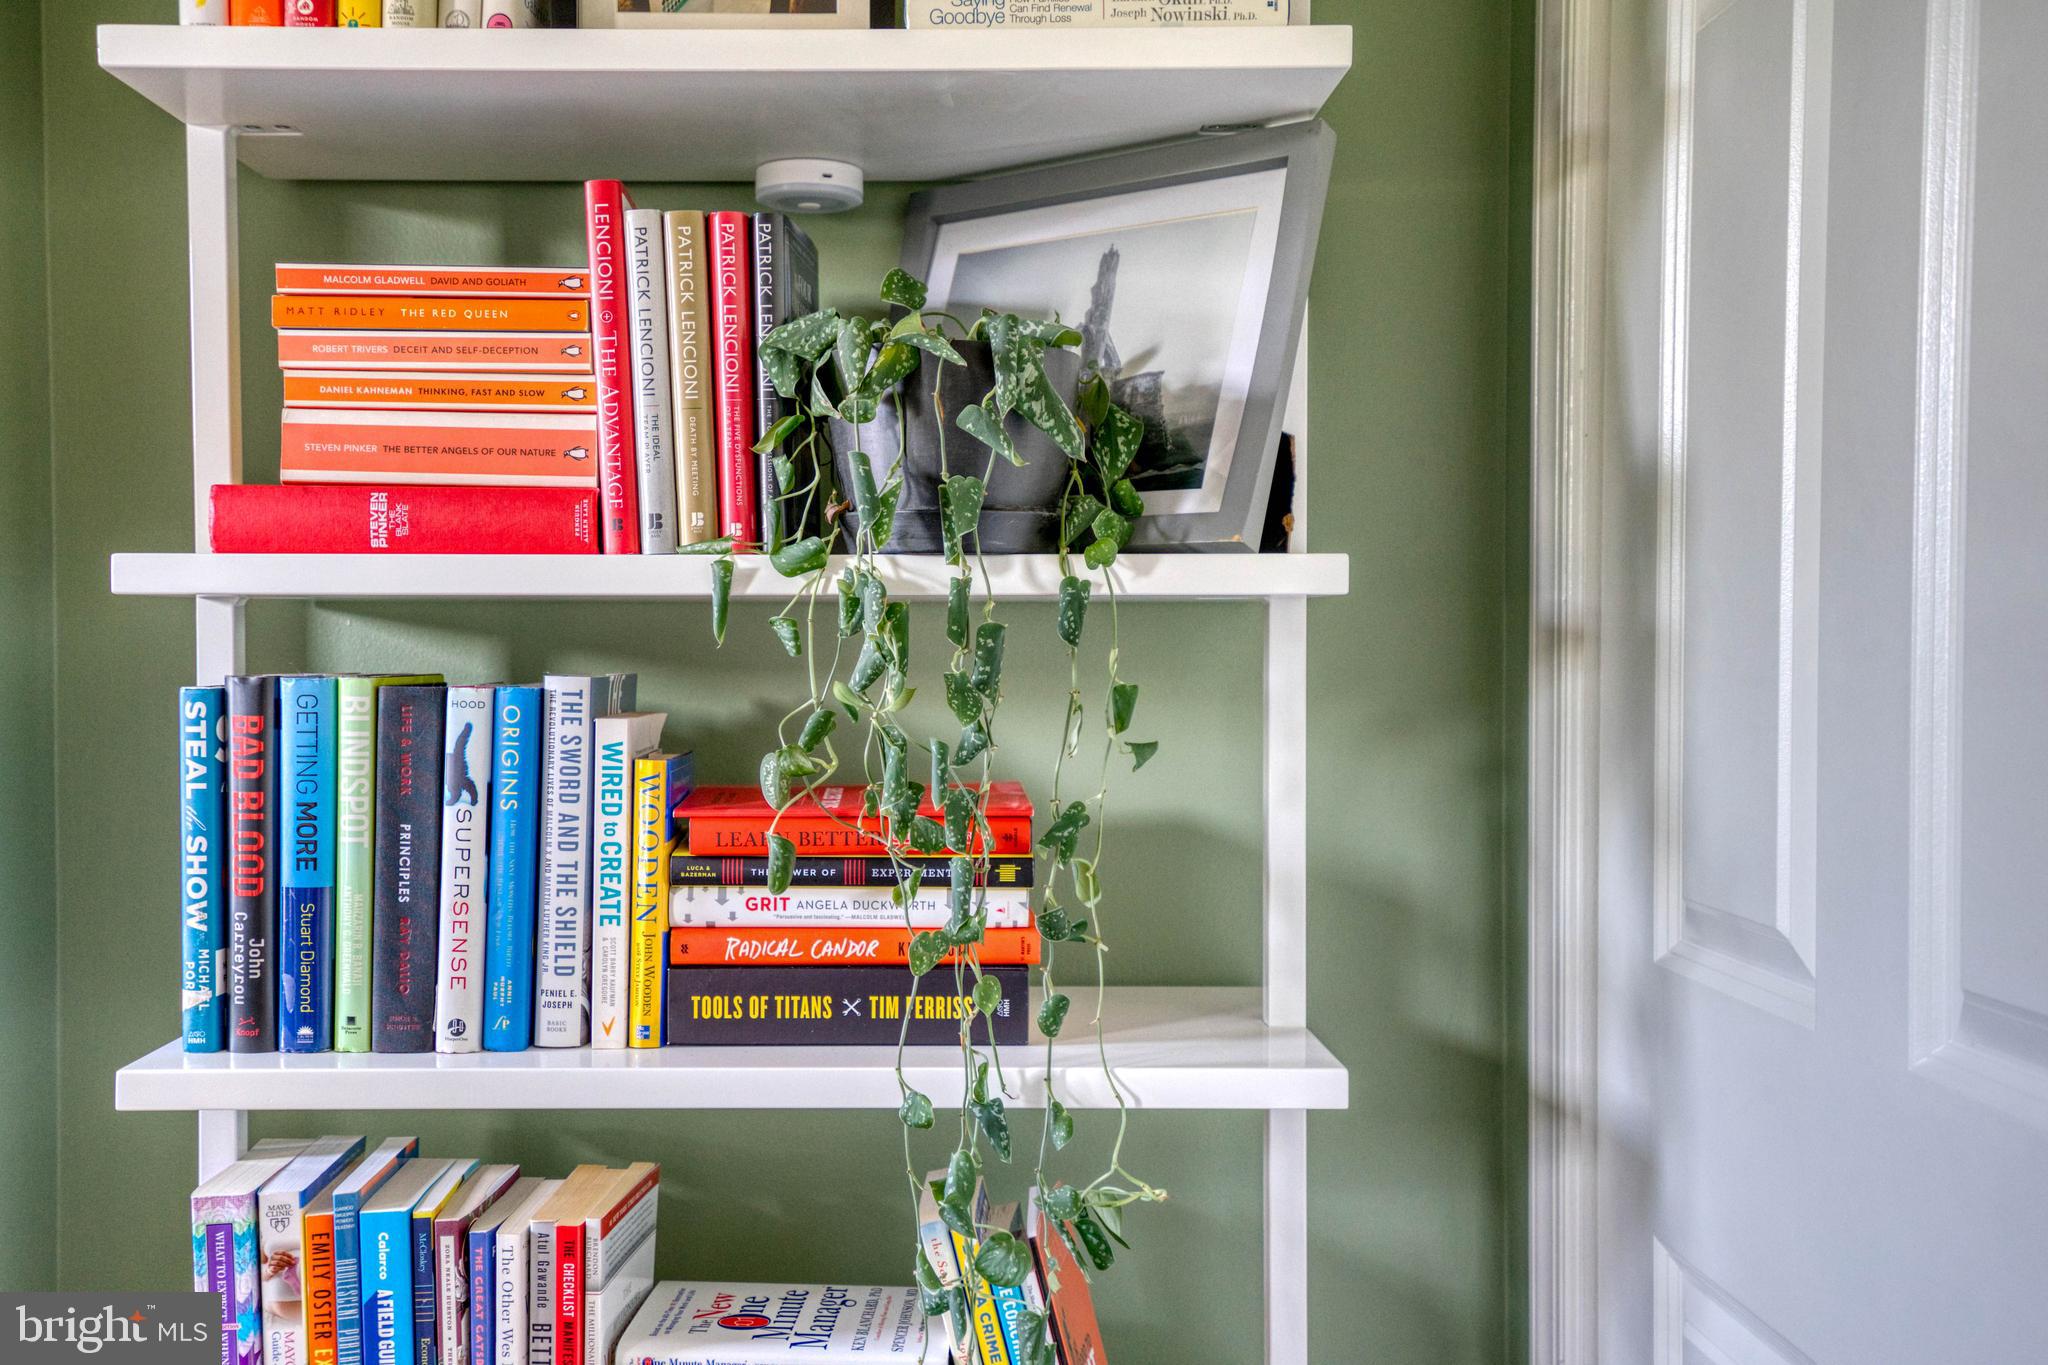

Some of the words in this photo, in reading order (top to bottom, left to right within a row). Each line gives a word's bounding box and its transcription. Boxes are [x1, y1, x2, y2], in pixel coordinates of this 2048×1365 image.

[929, 9, 1005, 27] Goodbye
[1009, 4, 1029, 13] Can
[1031, 4, 1050, 12] Find
[1053, 4, 1092, 12] Renewal
[1010, 14, 1047, 25] Through
[1049, 14, 1071, 23] Loss
[1110, 8, 1147, 19] Joseph
[1233, 12, 1258, 20] Ph.D.
[594, 203, 613, 300] LENCIONI
[634, 227, 651, 300] PATRICK
[678, 225, 695, 304] PATRICK
[720, 223, 737, 297] PATRICK
[758, 223, 773, 297] PATRICK
[323, 275, 371, 284] MALCOLM
[374, 276, 425, 285] GLADWELL
[430, 277, 460, 285] DAVID
[462, 278, 483, 286] AND
[486, 278, 527, 286] GOLIATH
[286, 307, 325, 316] MATT
[334, 307, 385, 316] RIDLEY
[400, 308, 425, 317] THE
[432, 309, 457, 318] RED
[464, 309, 509, 319] QUEEN
[312, 345, 349, 353] ROBERT
[352, 345, 388, 353] TRIVERS
[393, 346, 428, 354] DECEIT
[431, 346, 453, 354] AND
[456, 346, 539, 355] SELF-DECEPTION
[599, 330, 617, 377] THE
[638, 308, 655, 397] LENCIONI
[681, 311, 698, 400] LENCIONI
[722, 304, 739, 394] LENCIONI
[319, 385, 353, 394] DANIEL
[356, 386, 413, 395] KAHNEMAN
[418, 388, 468, 396] THINKING,
[471, 388, 492, 396] FAST
[495, 389, 516, 397] AND
[518, 389, 545, 397] SLOW
[651, 415, 660, 431] THE
[304, 443, 341, 452] STEVEN
[344, 444, 377, 453] PINKER
[383, 445, 401, 453] THE
[404, 445, 439, 454] BETTER
[441, 446, 479, 455] ANGELS
[481, 447, 494, 455] OF
[497, 448, 517, 456] OUR
[520, 449, 557, 457] NATURE
[602, 386, 623, 509] ADVANTAGE
[652, 433, 661, 461] IDEAL
[691, 460, 699, 497] MEETING
[734, 444, 743, 506] DYSFUNCTIONS
[369, 492, 379, 548] STEVEN
[378, 492, 388, 548] PINKER
[401, 704, 413, 733] LIFE
[451, 700, 486, 709] HOOD
[561, 689, 583, 726] THE
[185, 701, 207, 800] STEAL
[232, 715, 265, 779] BAD
[296, 694, 318, 795] GETTING
[500, 705, 521, 811] ORIGINS
[340, 695, 370, 848] BLINDSPOT
[400, 753, 412, 796] WORK
[559, 735, 582, 804] SWORD
[601, 741, 624, 816] WIRED
[185, 805, 207, 832] the
[296, 802, 318, 871] MORE
[558, 812, 580, 852] AND
[603, 821, 618, 837] to
[232, 792, 265, 897] BLOOD
[636, 771, 661, 924] WOODEN
[799, 832, 887, 847] BETTER
[398, 823, 411, 903] PRINCIPLES
[556, 860, 578, 898] THE
[186, 835, 208, 932] SHOW
[450, 808, 472, 990] SUPERSENSE
[600, 841, 622, 927] CREATE
[745, 897, 790, 911] GRIT
[797, 900, 848, 910] ANGELA
[853, 901, 936, 911] DUCKRTH
[300, 903, 315, 946] Stuart
[554, 906, 577, 977] SHIELD
[232, 912, 248, 1005] Carreyrou
[249, 938, 265, 979] John
[642, 930, 656, 962] JOHN
[725, 937, 803, 960] RADICAL
[811, 938, 880, 960] CANDOR
[300, 951, 315, 1013] Diamond
[540, 988, 567, 998] PENIEL
[569, 989, 577, 998] E.
[643, 965, 656, 1017] WOODEN
[542, 1000, 573, 1009] JOSEPH
[691, 995, 743, 1019] TOOLS
[749, 996, 768, 1019] OF
[775, 995, 833, 1019] TITANS
[869, 995, 899, 1019] TIM
[187, 1037, 206, 1045] HMH
[236, 1027, 260, 1037] Knopf
[268, 1203, 291, 1211] MAYO
[215, 1231, 226, 1262] WHAT
[312, 1233, 330, 1280] EMILY
[378, 1232, 390, 1280] Calarco
[418, 1233, 428, 1273] McCloskey
[475, 1248, 483, 1271] THE
[502, 1246, 514, 1274] The
[537, 1233, 550, 1254] Atul
[563, 1241, 575, 1258] THE
[931, 1238, 940, 1257] the
[216, 1264, 227, 1279] TO
[335, 1258, 359, 1320] ADOLESCENT
[537, 1261, 550, 1308] Gawande
[563, 1263, 575, 1317] CHECKLIST
[376, 1289, 394, 1299] A
[475, 1277, 484, 1319] GREAT
[502, 1281, 514, 1323] Other
[692, 1292, 737, 1319] New
[717, 1296, 771, 1330] One
[752, 1287, 810, 1341] Minute
[313, 1290, 332, 1340] OSTER
[377, 1299, 395, 1338] FIELD
[688, 1319, 713, 1335] The
[789, 1286, 857, 1350] Manager
[272, 1331, 281, 1361] Guide
[502, 1329, 514, 1358] Wes
[851, 1334, 866, 1351] KEN
[891, 1324, 909, 1352] SPENCER
[980, 1313, 1002, 1364] CRIME
